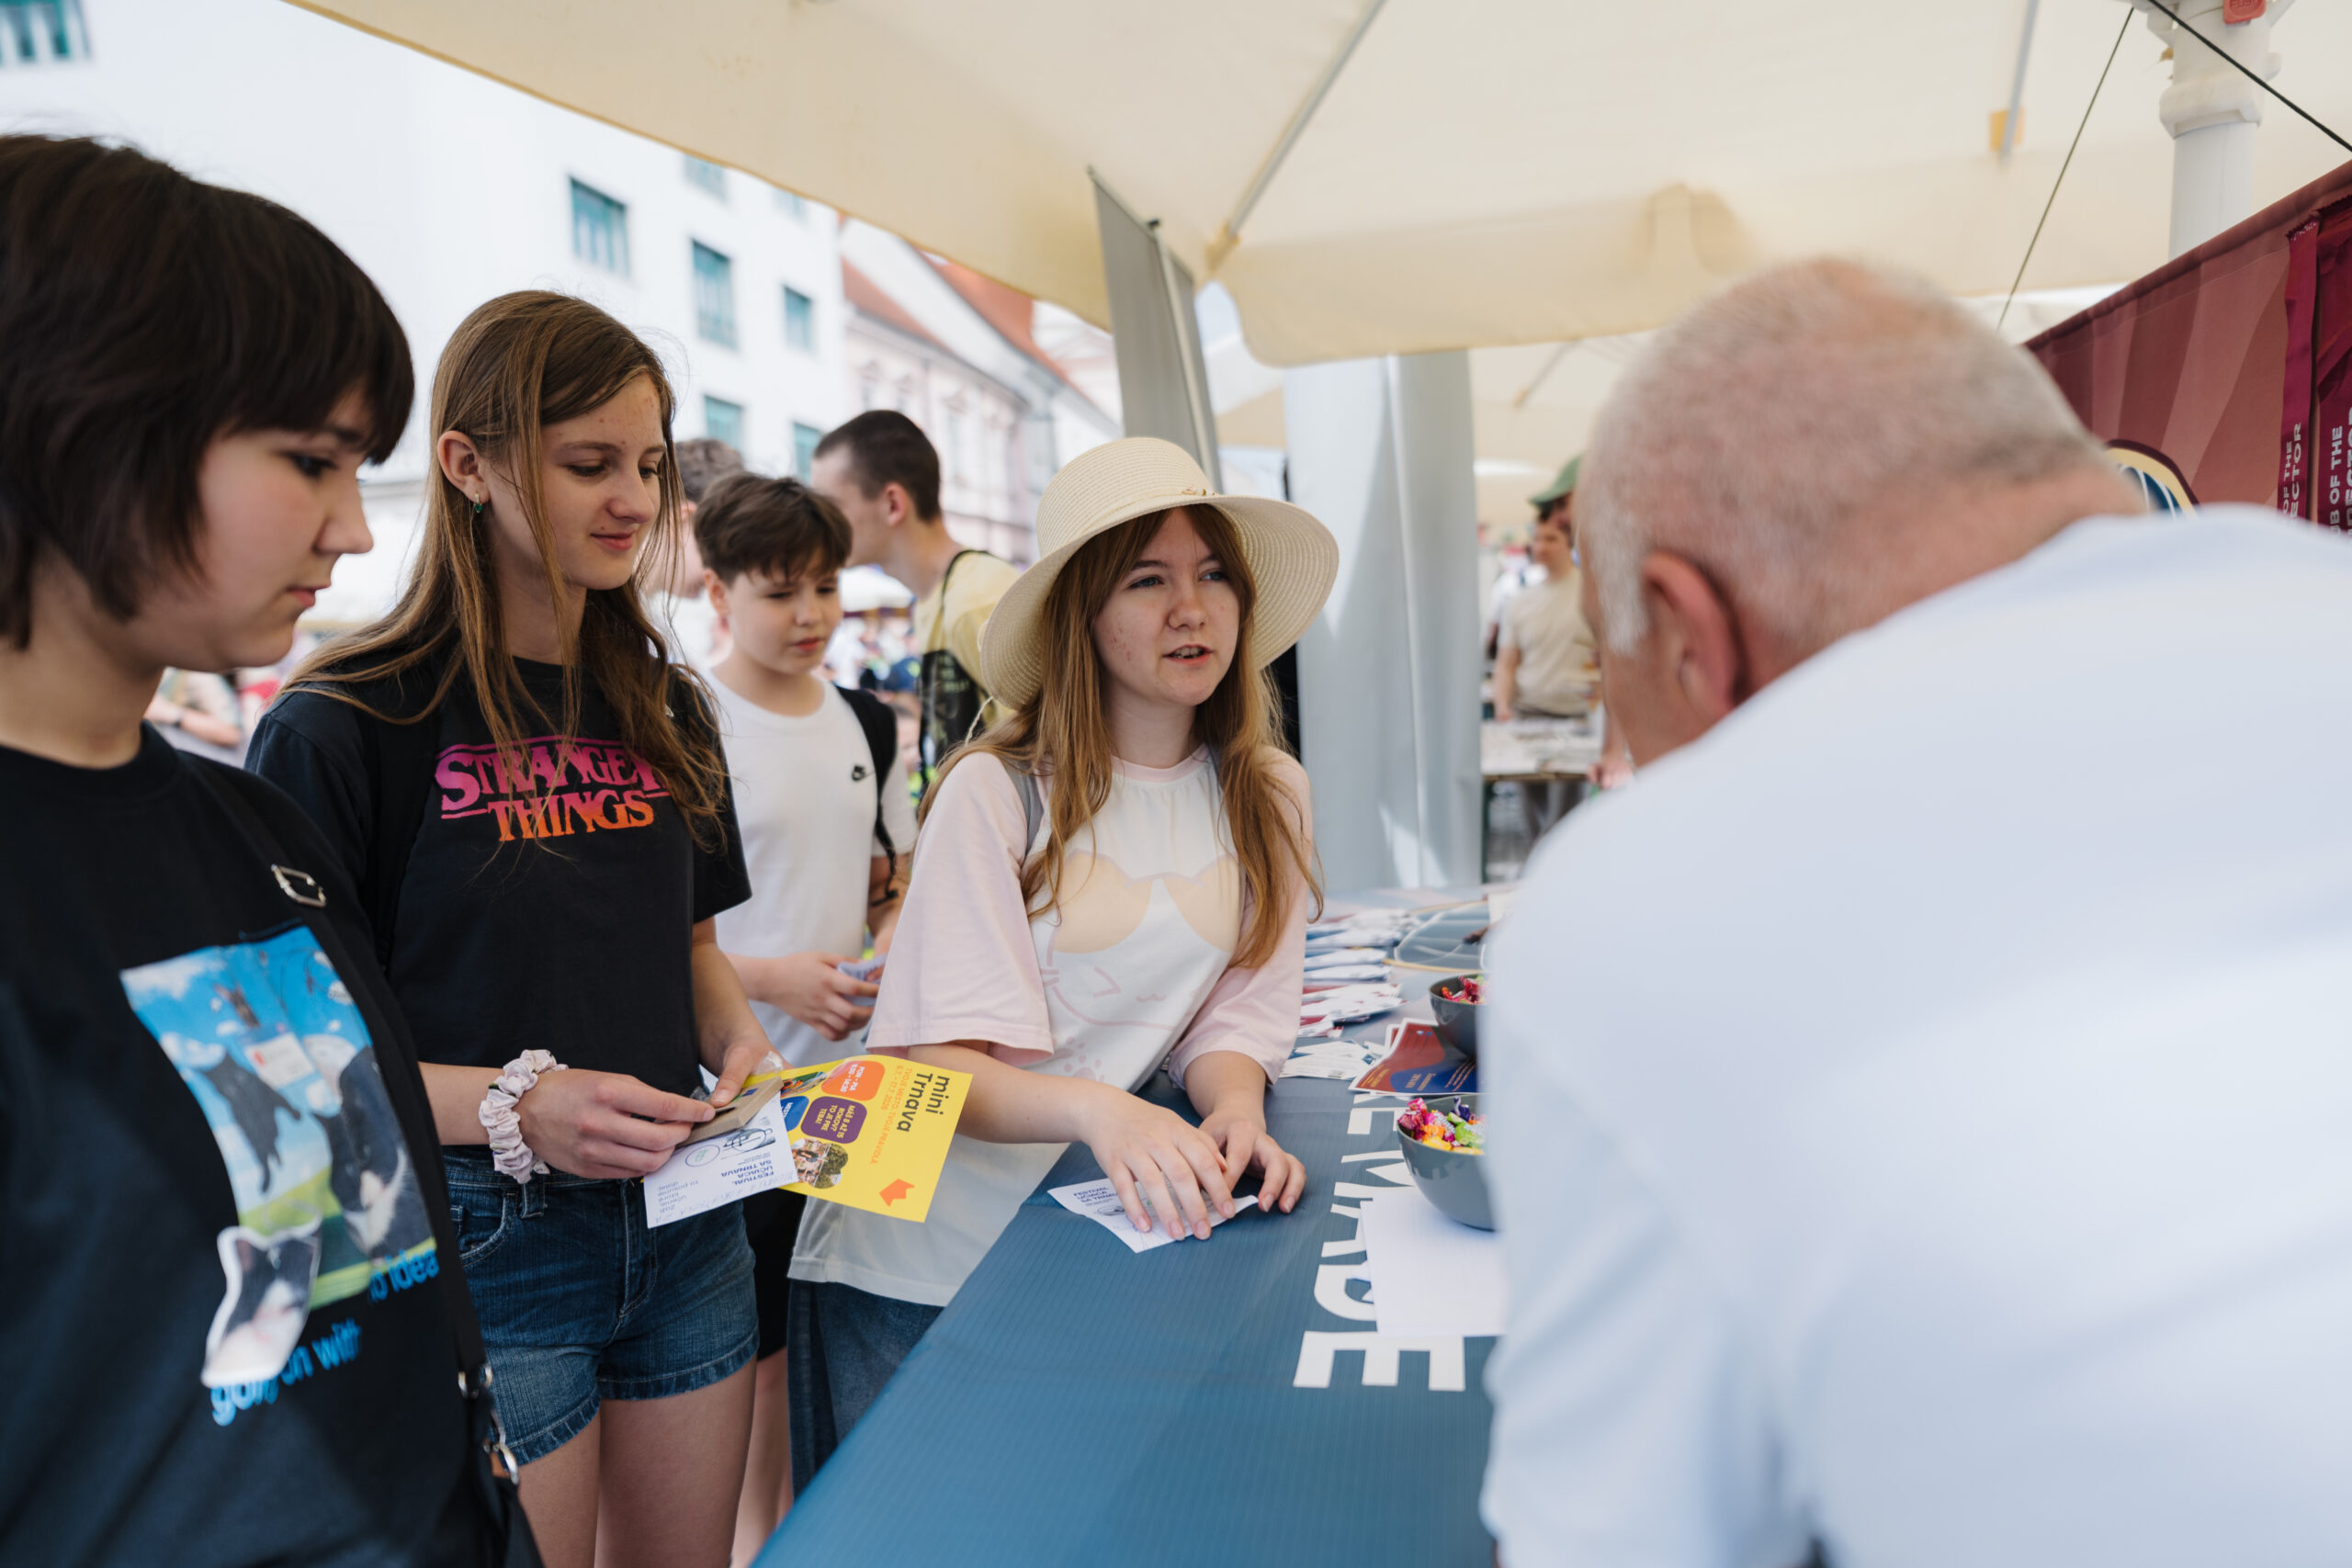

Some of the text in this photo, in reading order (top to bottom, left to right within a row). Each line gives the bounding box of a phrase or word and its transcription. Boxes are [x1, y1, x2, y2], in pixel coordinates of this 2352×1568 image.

[2283, 441, 2292, 481] THE
[2331, 425, 2343, 470] THE
[2290, 423, 2301, 518] ECTOR
[2329, 475, 2341, 504] OF
[487, 789, 654, 841] THINGS
[896, 1073, 933, 1133] Trnava
[925, 1076, 950, 1115] mini
[820, 1104, 838, 1132] TO JE PRE
[831, 1107, 845, 1132] ROKOV?
[720, 1164, 757, 1177] TRNAVA
[732, 1171, 775, 1186] FESTIVAL
[385, 1248, 440, 1292] idea
